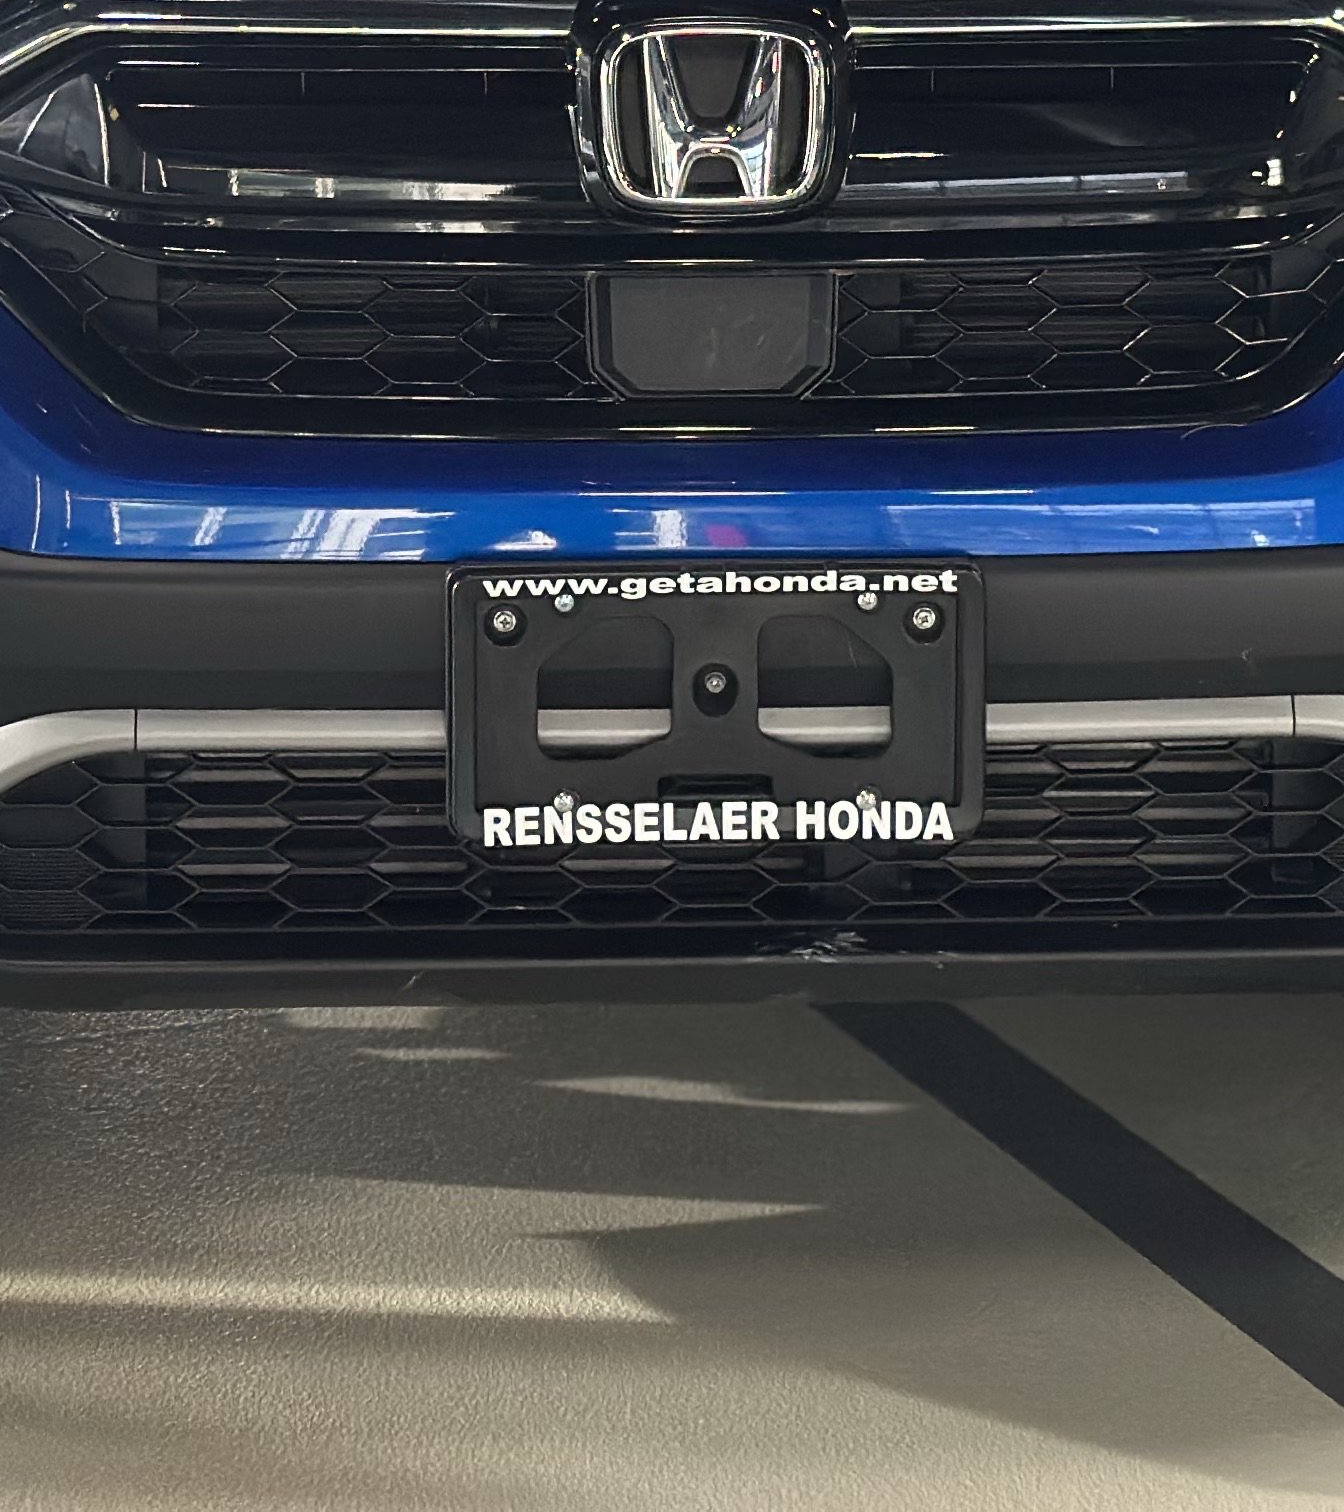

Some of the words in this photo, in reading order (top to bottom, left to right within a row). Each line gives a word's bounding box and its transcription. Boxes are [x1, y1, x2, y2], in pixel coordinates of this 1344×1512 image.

[483, 569, 958, 600] www.getahonda.net
[483, 801, 780, 847] RENSSELAER
[796, 800, 954, 841] HONDA
